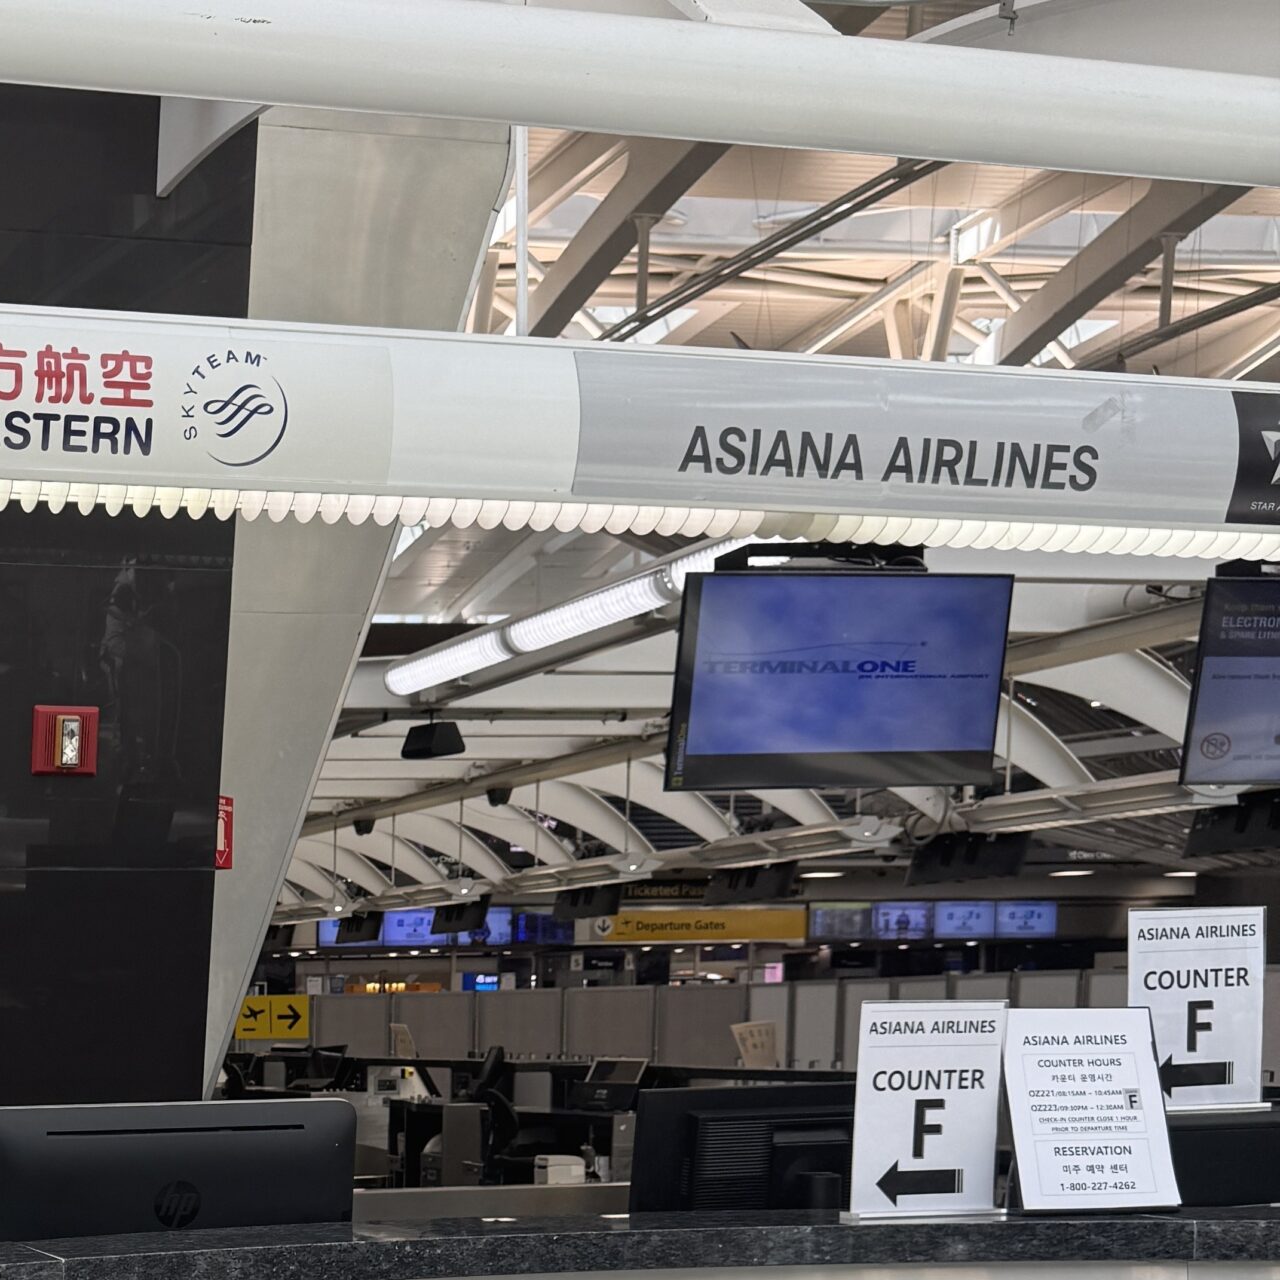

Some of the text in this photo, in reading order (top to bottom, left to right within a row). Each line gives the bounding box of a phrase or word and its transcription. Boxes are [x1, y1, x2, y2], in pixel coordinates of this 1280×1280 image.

[677, 425, 1100, 492] ASIANA AIRLINES
[1250, 501, 1276, 512] STAR
[635, 920, 726, 933] Departure Gates
[1137, 924, 1257, 941] ASIANA AIRLINES
[1143, 967, 1250, 991] COUNTER
[869, 1019, 997, 1035] ASIANA AIRLINES
[1186, 1000, 1214, 1053] F
[1022, 1034, 1128, 1046] ASIANA AIRLINES
[1037, 1058, 1122, 1068] COUNTER HOURS
[872, 1069, 985, 1091] COUNTER
[1080, 1073, 1113, 1082] 운영시간
[1128, 1094, 1138, 1109] F
[912, 1098, 946, 1159] F
[1053, 1145, 1132, 1157] RESERVATION
[1062, 1164, 1128, 1174] 미주 예약 센터
[1060, 1181, 1136, 1191] 1-800-227-4262
